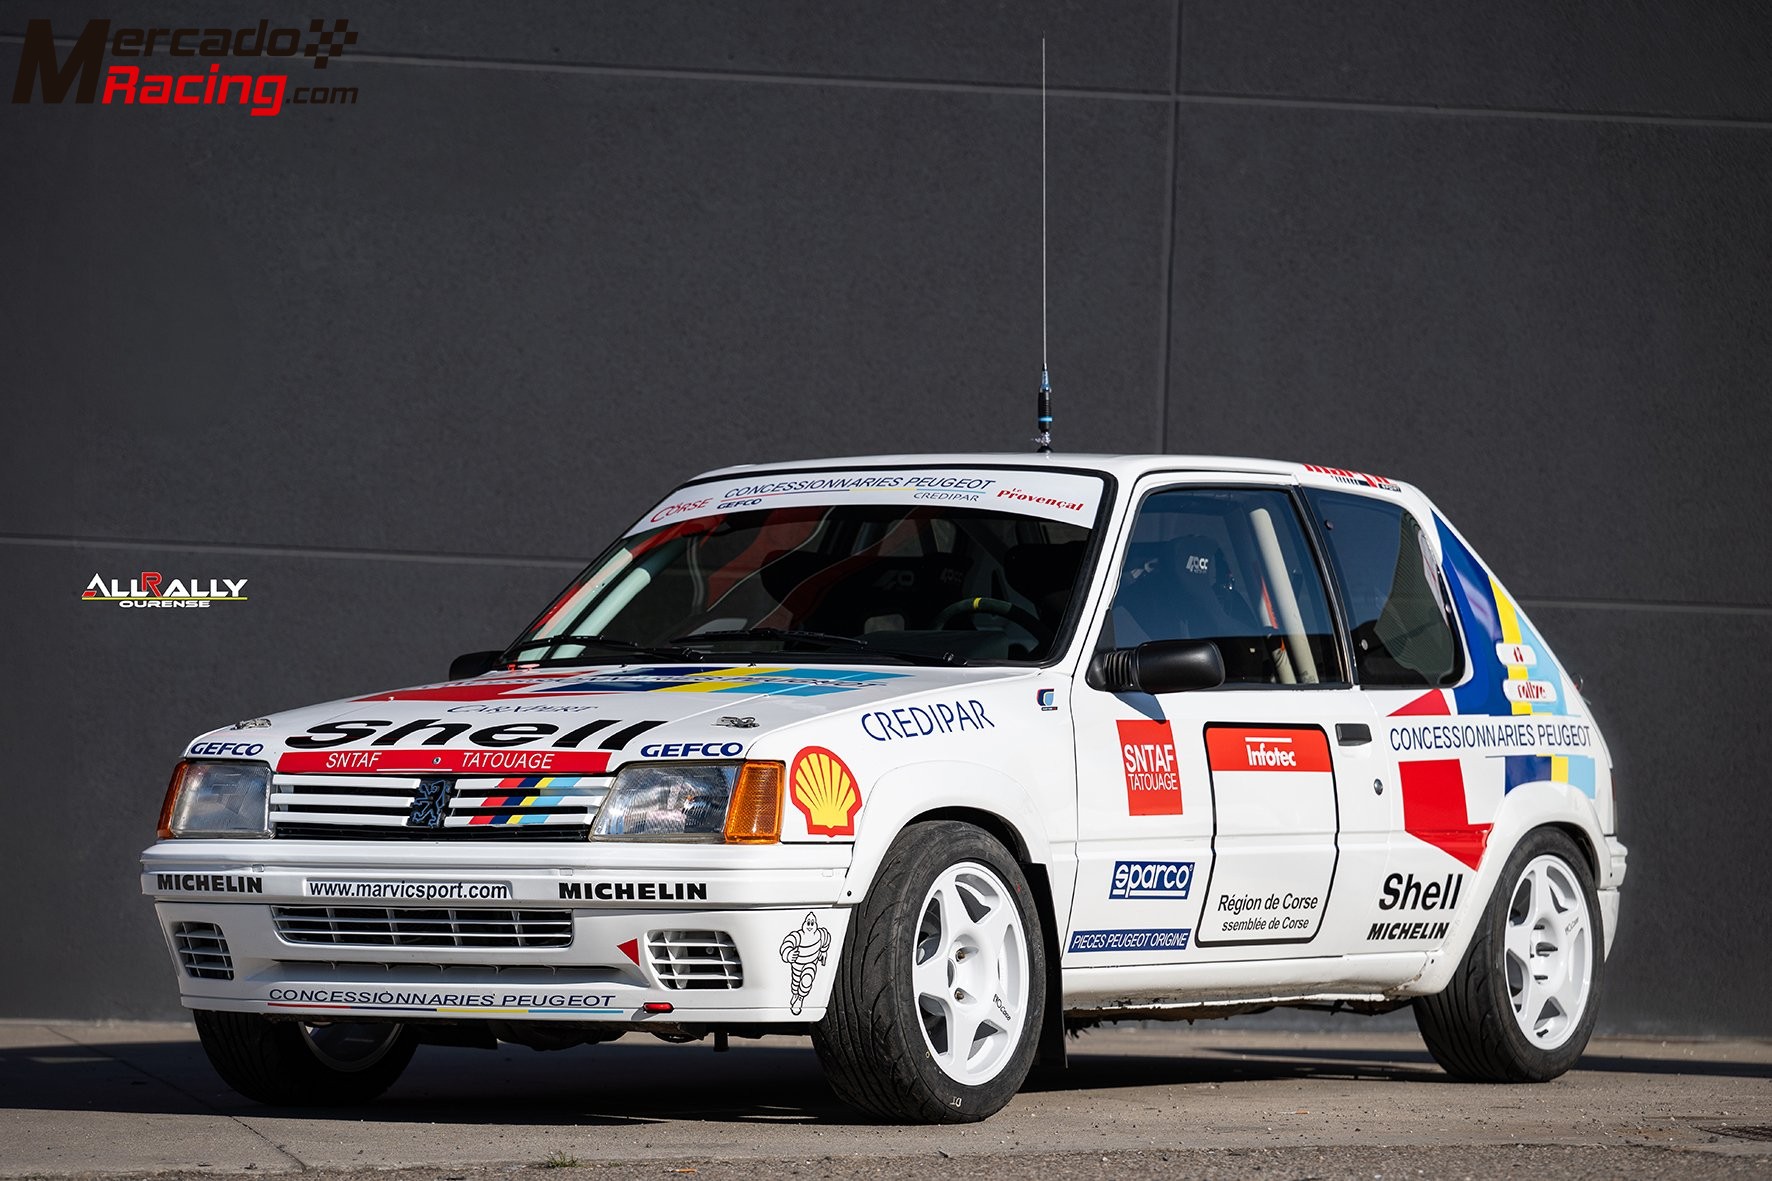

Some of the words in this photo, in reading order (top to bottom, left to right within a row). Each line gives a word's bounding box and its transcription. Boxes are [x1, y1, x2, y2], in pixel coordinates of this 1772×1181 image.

[725, 477, 904, 498] CONCESSIONNARIES
[903, 477, 996, 490] PEUGEOT
[913, 492, 979, 502] CREDIPAR
[717, 498, 762, 510] GEFCO
[996, 489, 1084, 511] Provençal
[861, 700, 995, 742] CREDIPAR
[285, 719, 668, 750] Shell
[1390, 725, 1536, 750] CONCESSIONNARIES
[1538, 724, 1592, 747] PEUGEOT
[191, 742, 264, 756] GEFCO
[640, 742, 743, 757] GEFCO
[1125, 744, 1175, 773] SNTAF
[1246, 742, 1296, 766] Infotec
[326, 752, 382, 769] SNTAF
[461, 753, 554, 769] TATOUAGE
[1128, 772, 1179, 791] TATOUAGE
[157, 874, 263, 894] MICHELIN
[310, 880, 508, 901] www.marvicsport.com
[559, 882, 707, 900] MICHELIN
[1115, 864, 1189, 898] sparco
[1379, 873, 1463, 910] Shell
[1218, 894, 1261, 915] Région
[1264, 893, 1280, 910] de
[1282, 893, 1318, 910] Corse
[1222, 917, 1267, 931] ssemblée
[1268, 917, 1280, 929] de
[1282, 916, 1309, 929] Corse
[1366, 922, 1450, 940] MICHELIN
[1071, 934, 1107, 949] PIECES
[1105, 932, 1151, 948] PEUGEOT
[1150, 932, 1188, 947] ORIGINE
[269, 988, 495, 1007] CONCESSIONNARIES
[502, 995, 615, 1008] PEUGEOT
